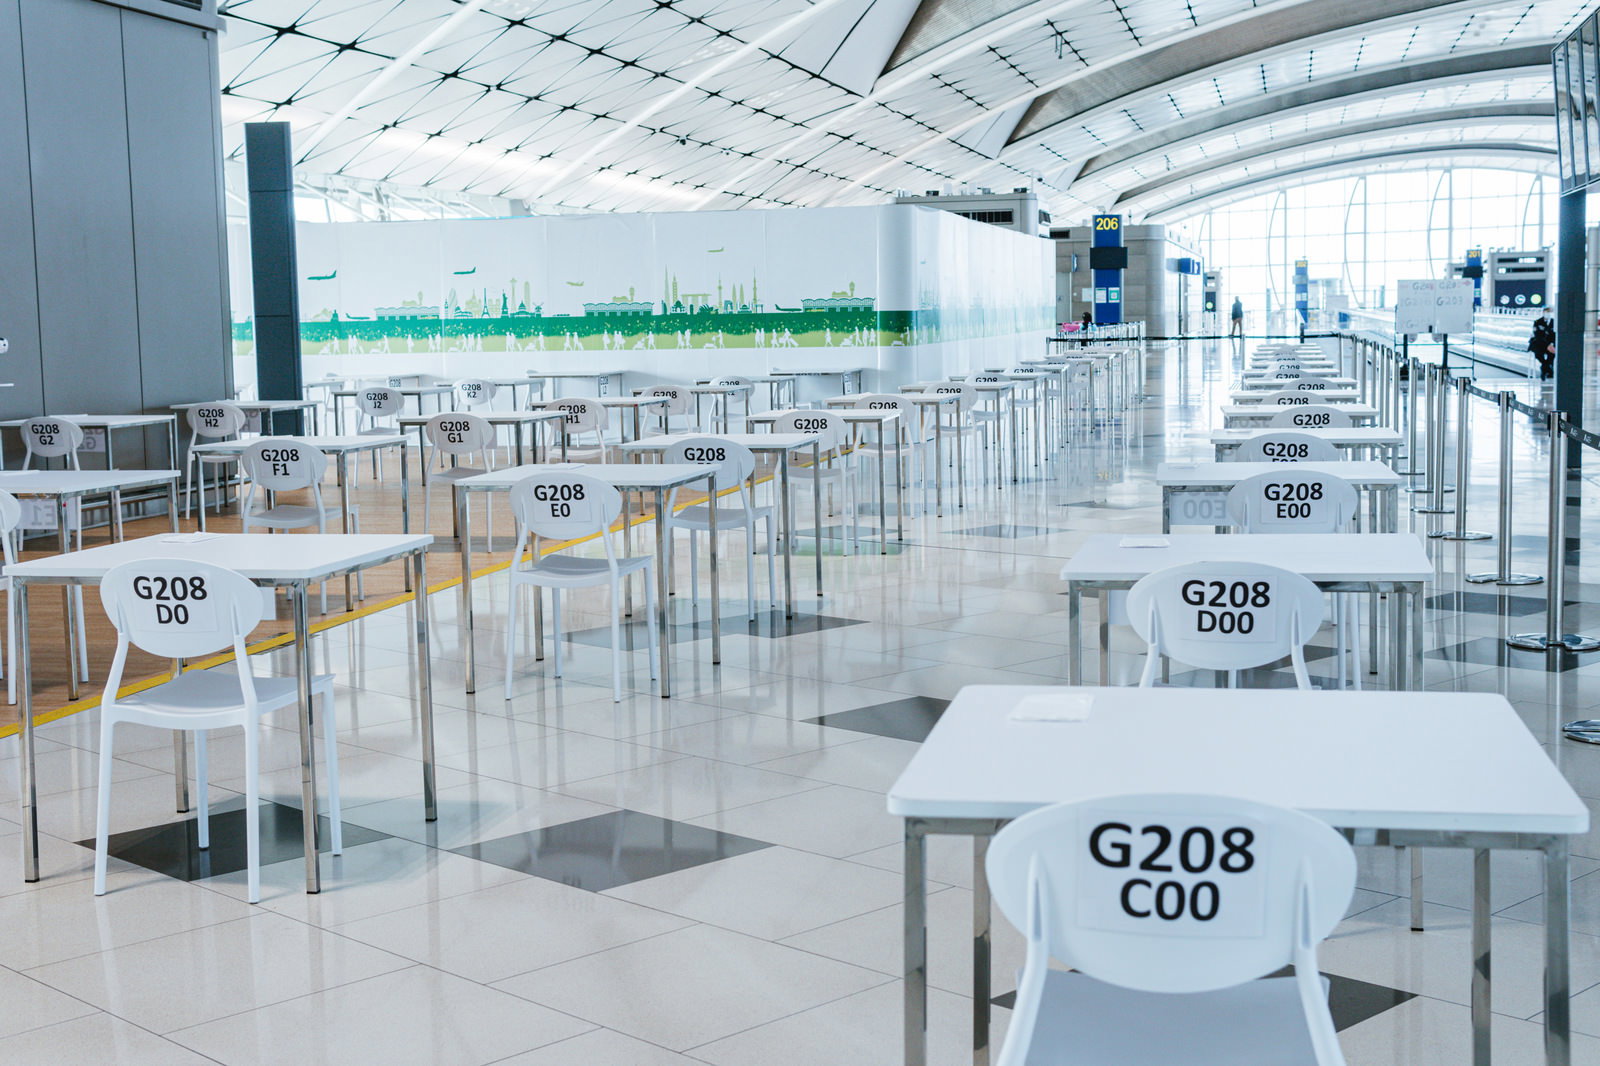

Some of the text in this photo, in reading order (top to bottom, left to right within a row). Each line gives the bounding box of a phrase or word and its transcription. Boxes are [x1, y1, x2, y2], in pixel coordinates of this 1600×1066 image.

[1096, 218, 1118, 230] 206
[366, 393, 388, 401] G208
[373, 401, 382, 409] J2
[198, 408, 225, 418] G208
[566, 415, 580, 424] H1
[205, 419, 219, 428] H2
[440, 421, 470, 432] G208
[794, 419, 828, 430] G208
[1293, 414, 1330, 426] G208
[31, 424, 60, 435] G208
[39, 435, 55, 446] G2
[448, 433, 464, 443] G1
[261, 449, 300, 462] G208
[684, 447, 726, 461] G208
[1263, 442, 1309, 458] G208
[273, 463, 290, 476] F1
[534, 484, 585, 502] G208
[1264, 483, 1323, 501] G208
[551, 503, 571, 517] E0
[1276, 503, 1311, 518] E00
[133, 576, 208, 602] G208
[1181, 580, 1271, 608] G208
[156, 604, 189, 624] D0
[1197, 610, 1254, 634] D00
[1088, 822, 1255, 874] G208
[1120, 878, 1220, 921] C00
